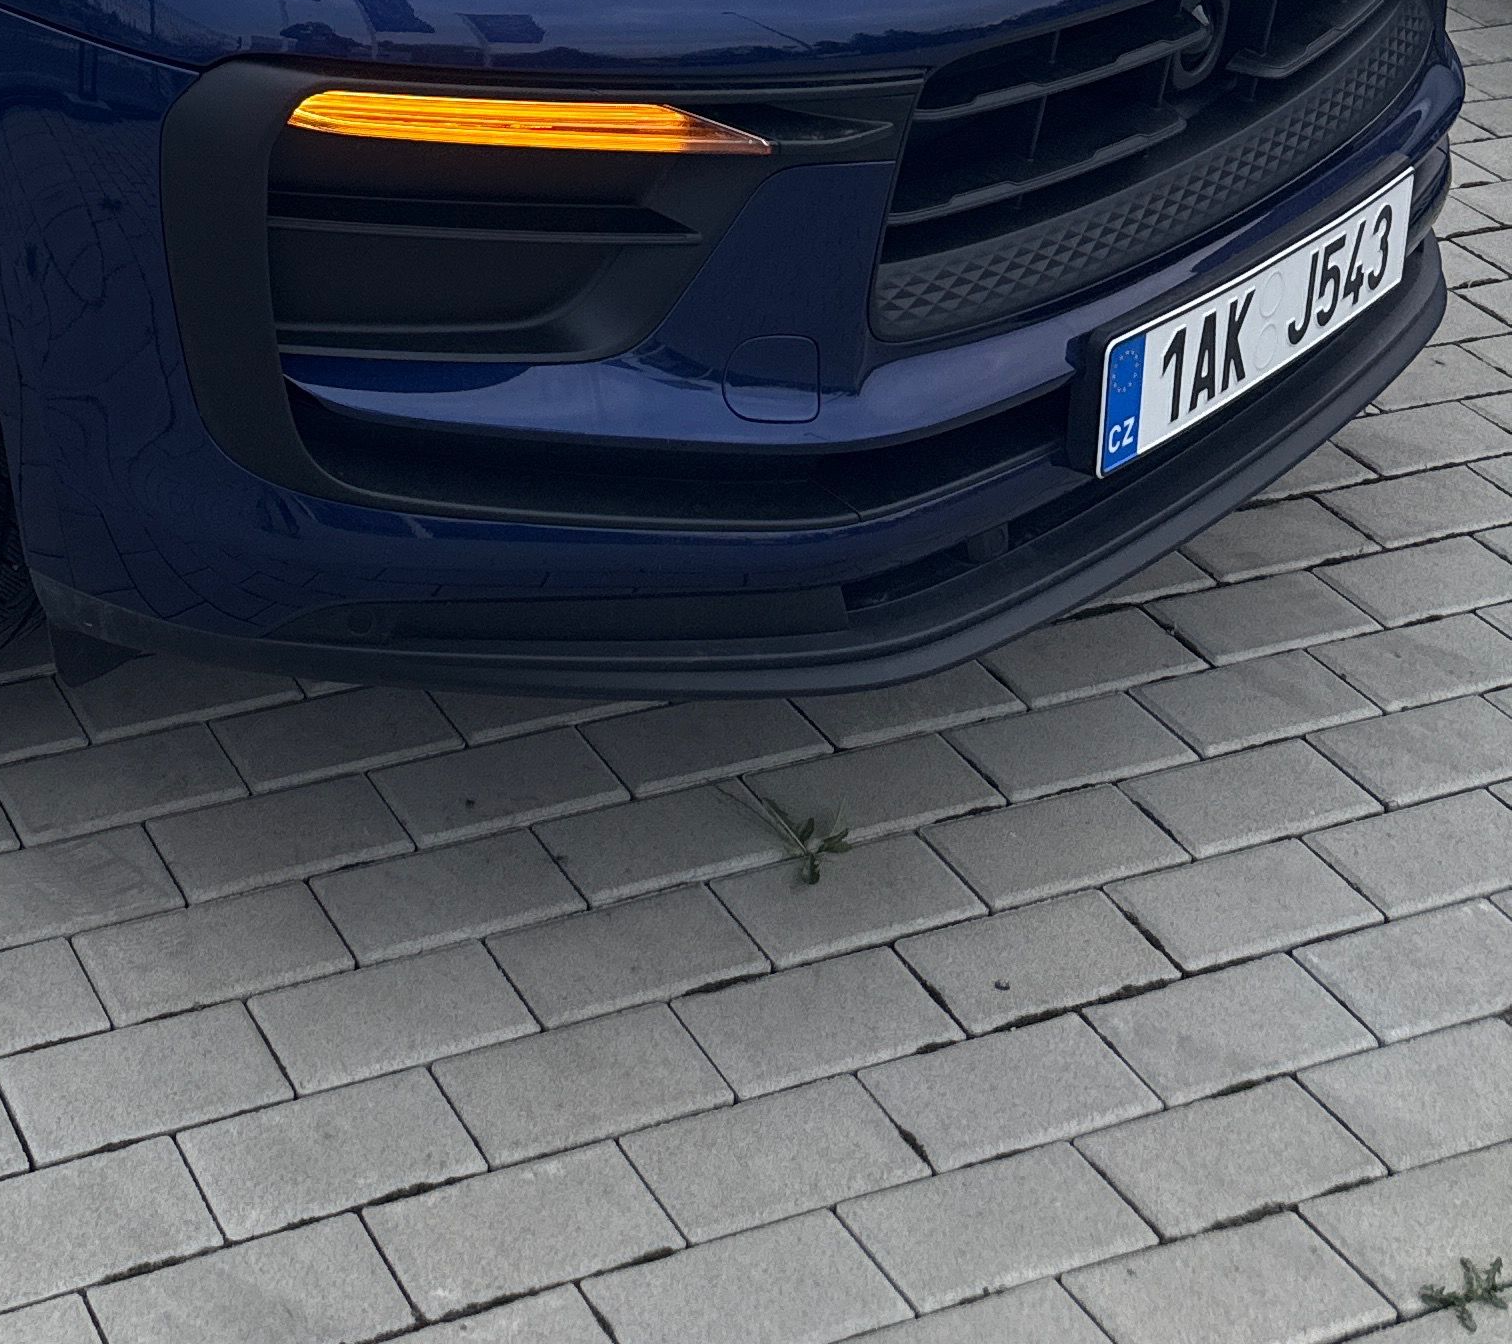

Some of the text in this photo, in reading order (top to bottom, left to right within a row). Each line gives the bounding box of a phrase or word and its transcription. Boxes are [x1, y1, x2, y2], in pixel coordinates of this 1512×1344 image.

[1161, 204, 1393, 424] 1AK J543
[1107, 415, 1136, 454] CZ
